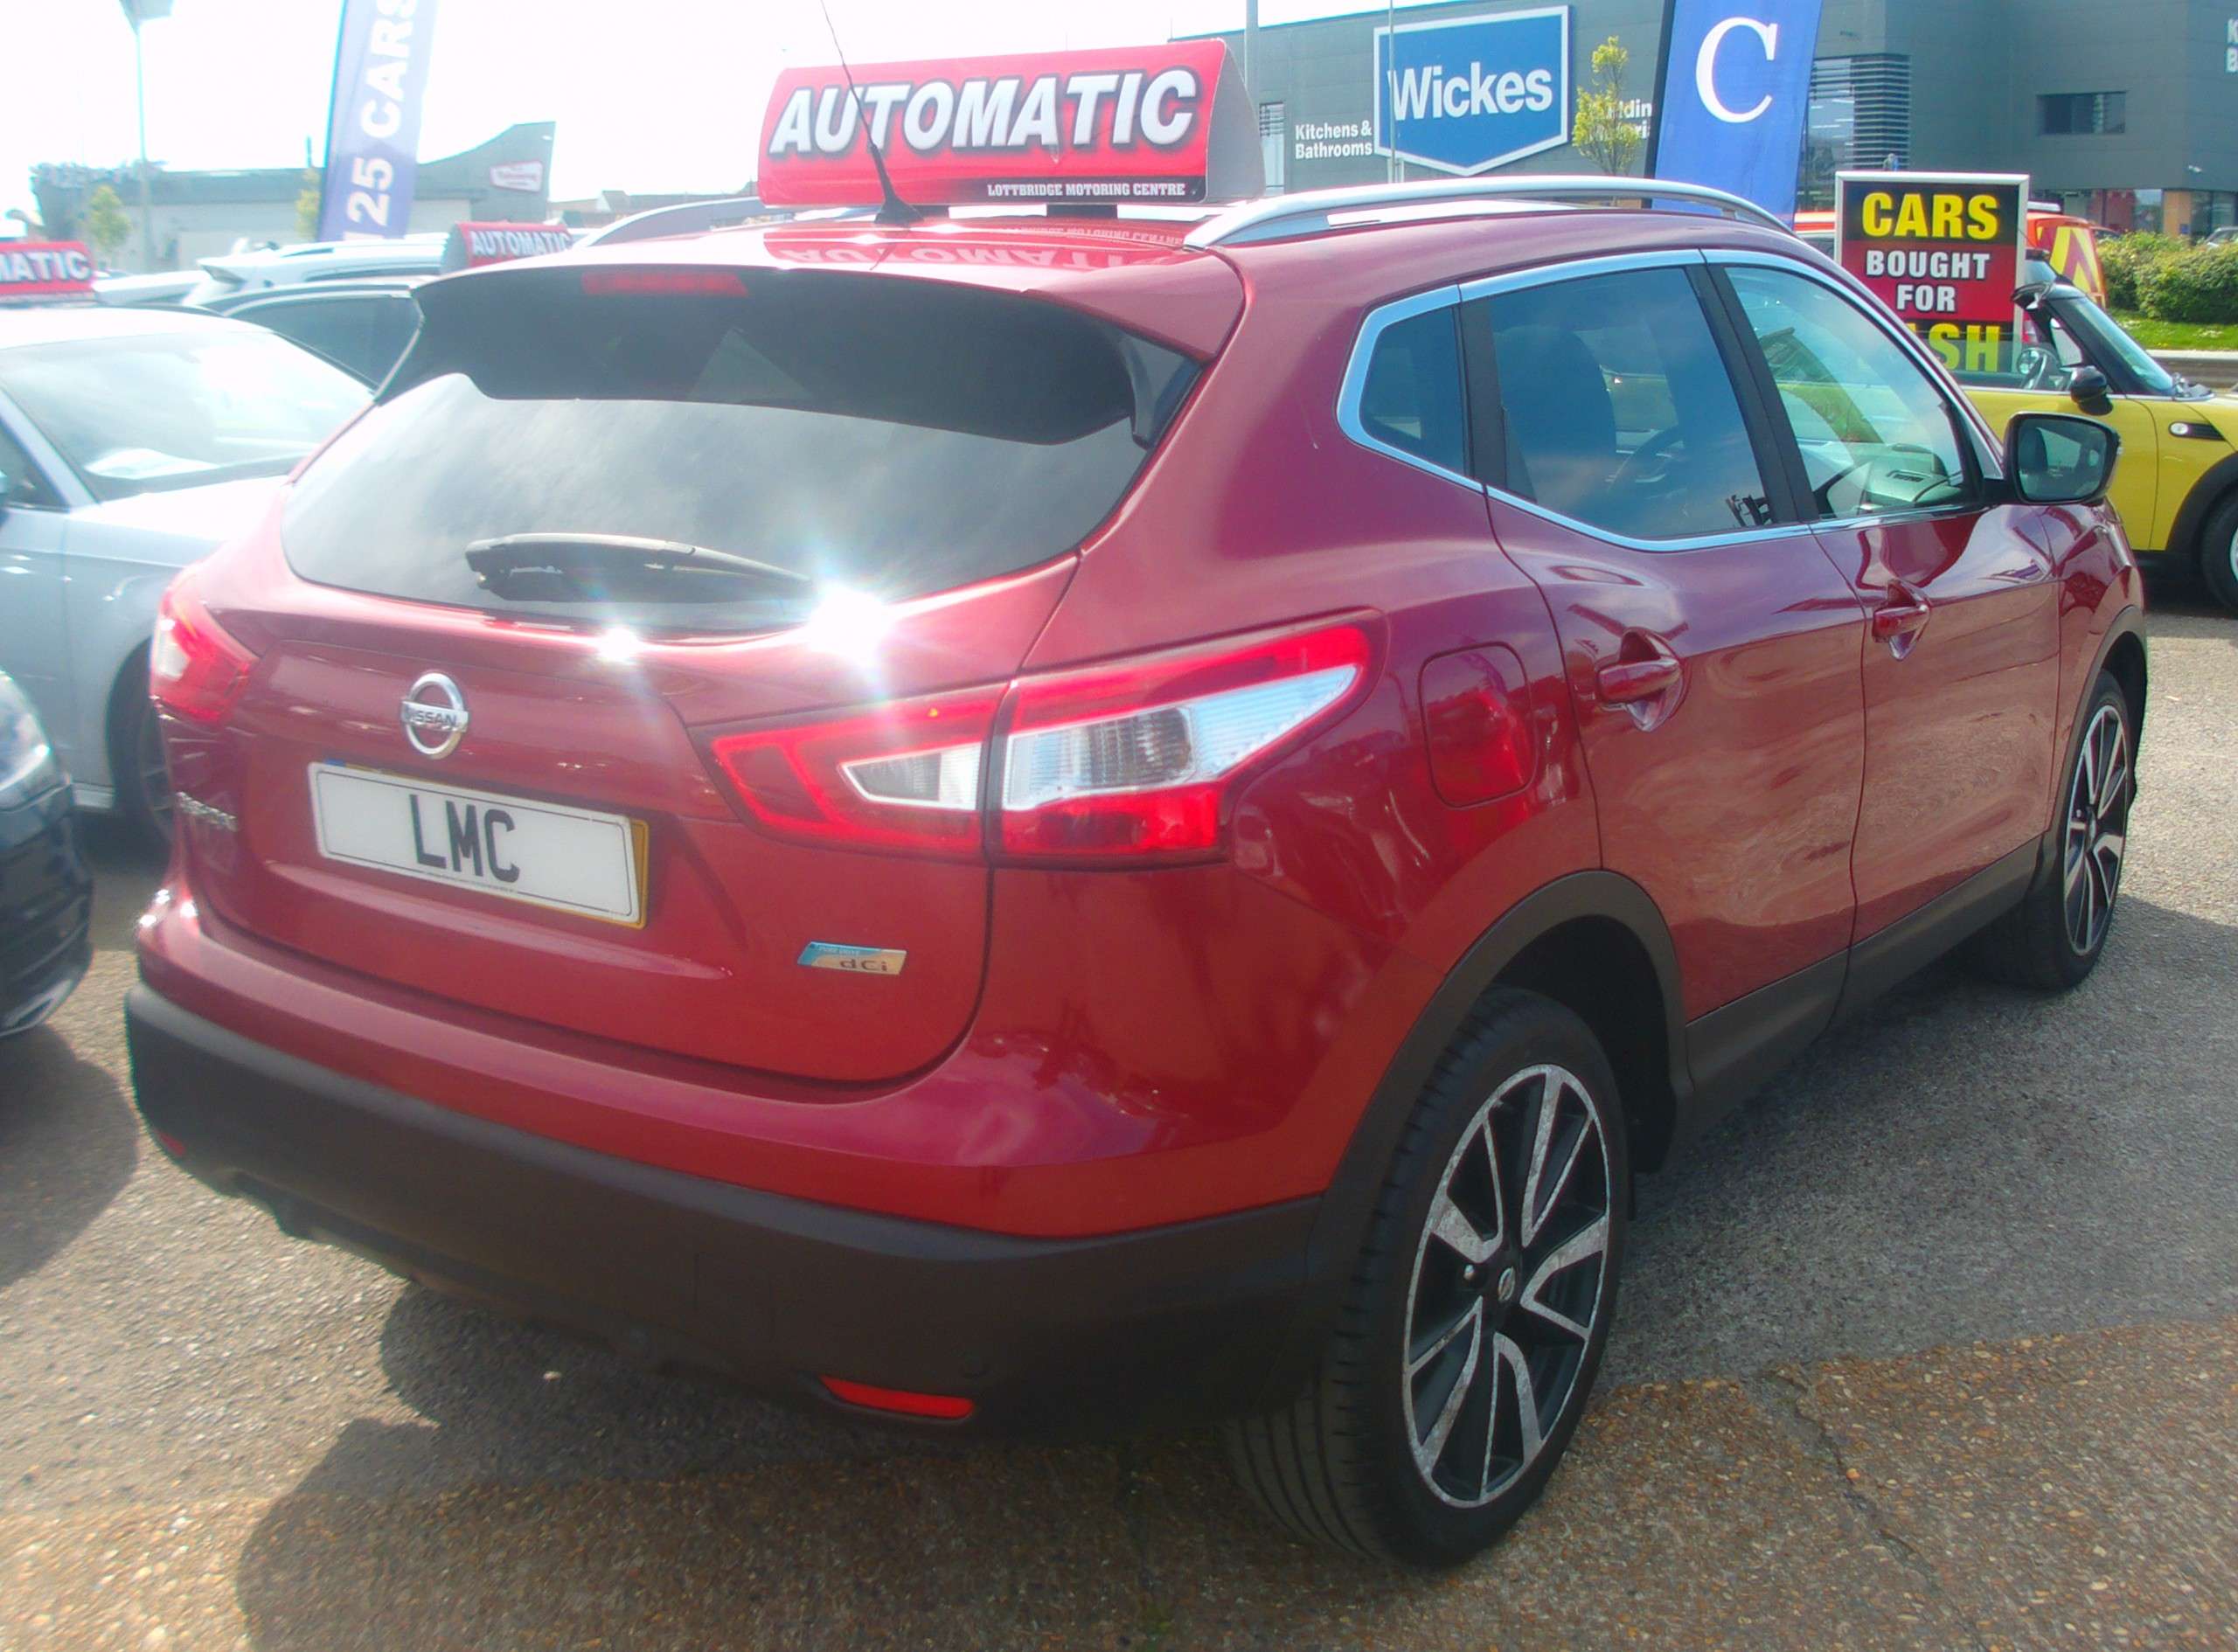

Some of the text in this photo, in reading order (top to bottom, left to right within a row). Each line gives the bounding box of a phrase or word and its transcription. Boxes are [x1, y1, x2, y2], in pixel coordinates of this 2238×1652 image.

[1696, 17, 1778, 123] C
[1387, 61, 1553, 121] Wickes
[769, 69, 1196, 154] AUTOMATIC
[1295, 119, 1373, 141] Kitchens &
[1295, 142, 1373, 160] Bathrooms
[987, 182, 1185, 197] LOTTBRIDGE MOTORING CENTRE
[1862, 191, 1998, 240] CARS
[1866, 249, 1991, 280] BOUGHT
[1897, 284, 1956, 312] FOR
[1906, 323, 2000, 372] SH
[409, 794, 520, 883] LMC
[840, 958, 888, 972] dCi
